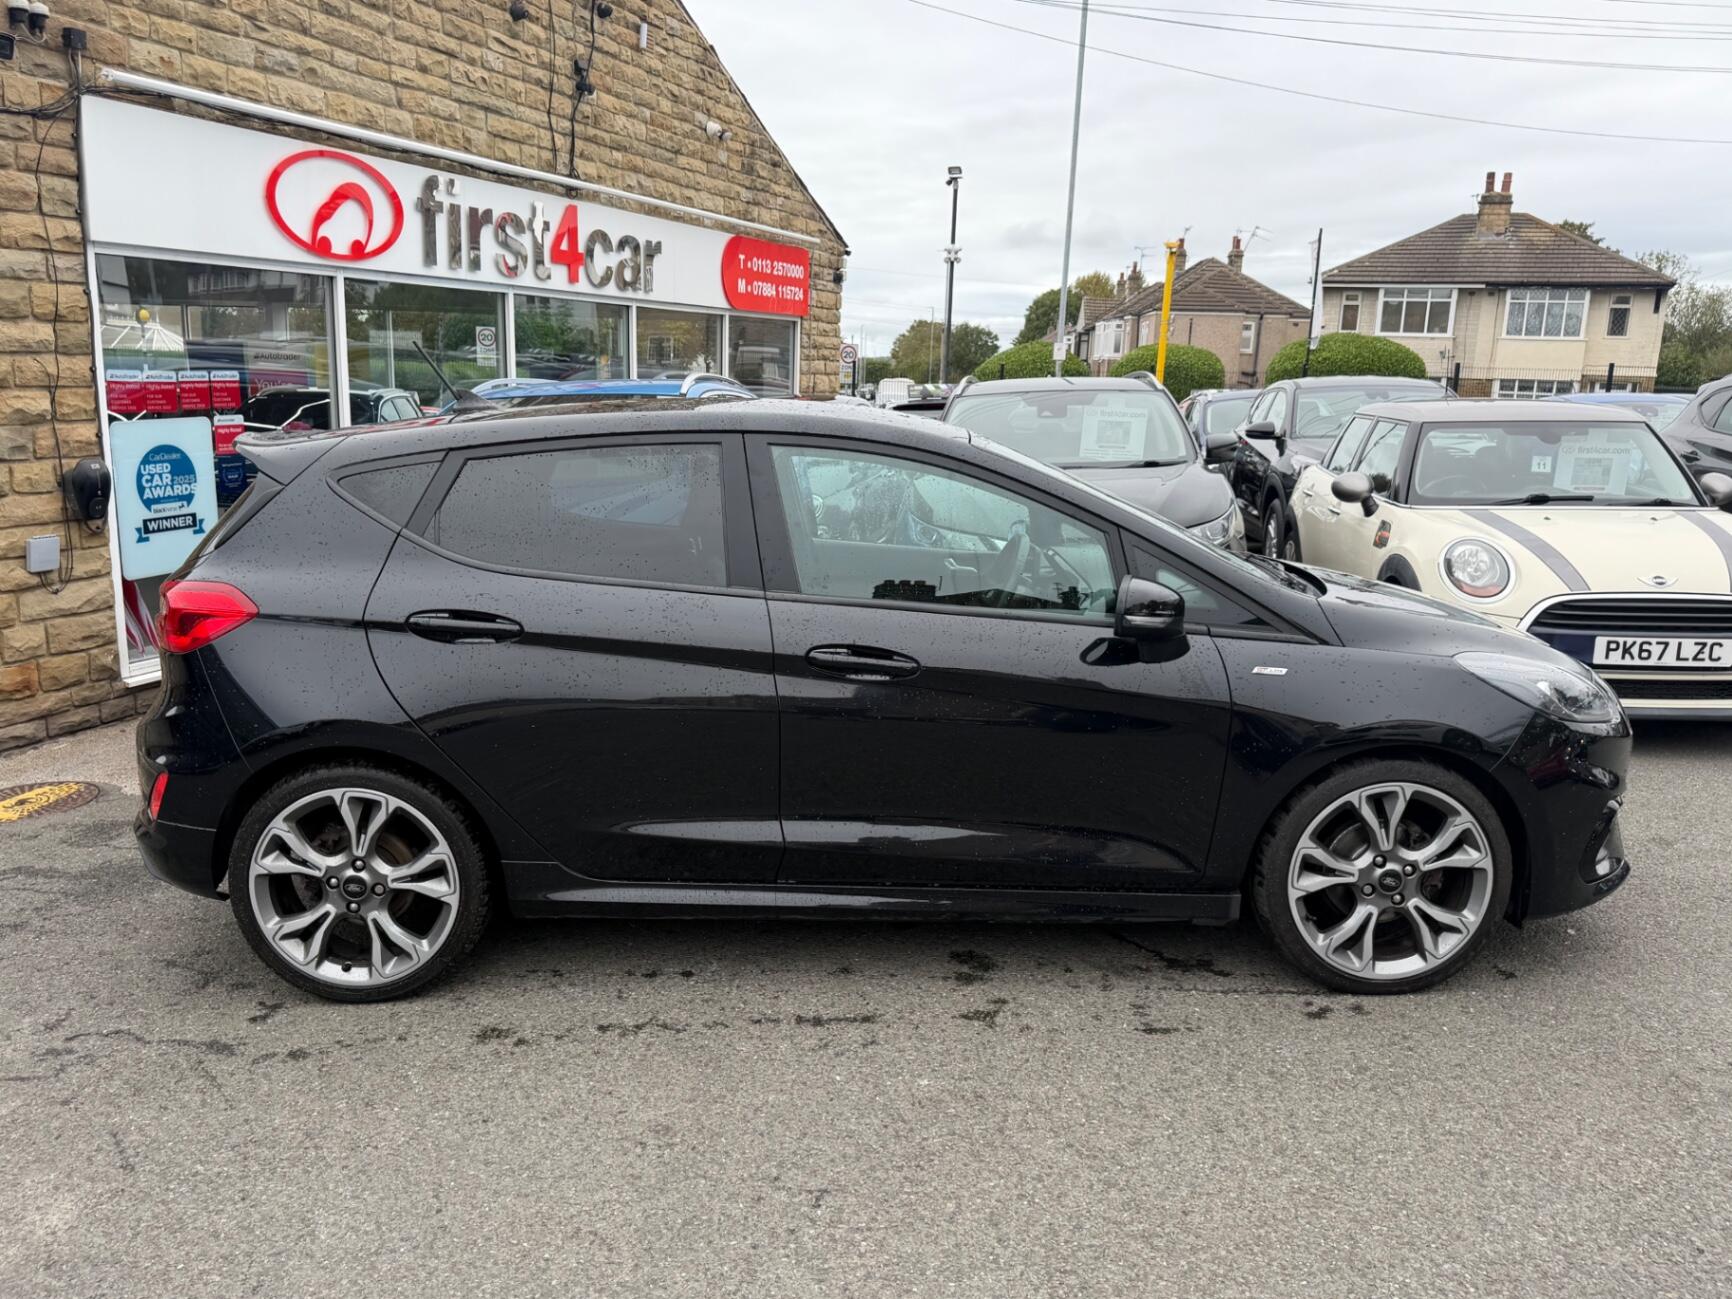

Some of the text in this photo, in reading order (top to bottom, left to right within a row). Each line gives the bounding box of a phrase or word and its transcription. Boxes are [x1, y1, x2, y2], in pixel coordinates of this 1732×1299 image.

[416, 175, 662, 293] first4car
[738, 254, 804, 279] T 0113 2570000
[737, 278, 804, 301] M 07884 115724
[843, 351, 855, 359] 20
[140, 463, 171, 474] USED
[1537, 462, 1546, 470] 11
[141, 473, 196, 487] CAR 2025
[143, 483, 198, 500] AWARDS
[147, 516, 193, 531] WINNER
[1605, 640, 1724, 662] PK67 LZC
